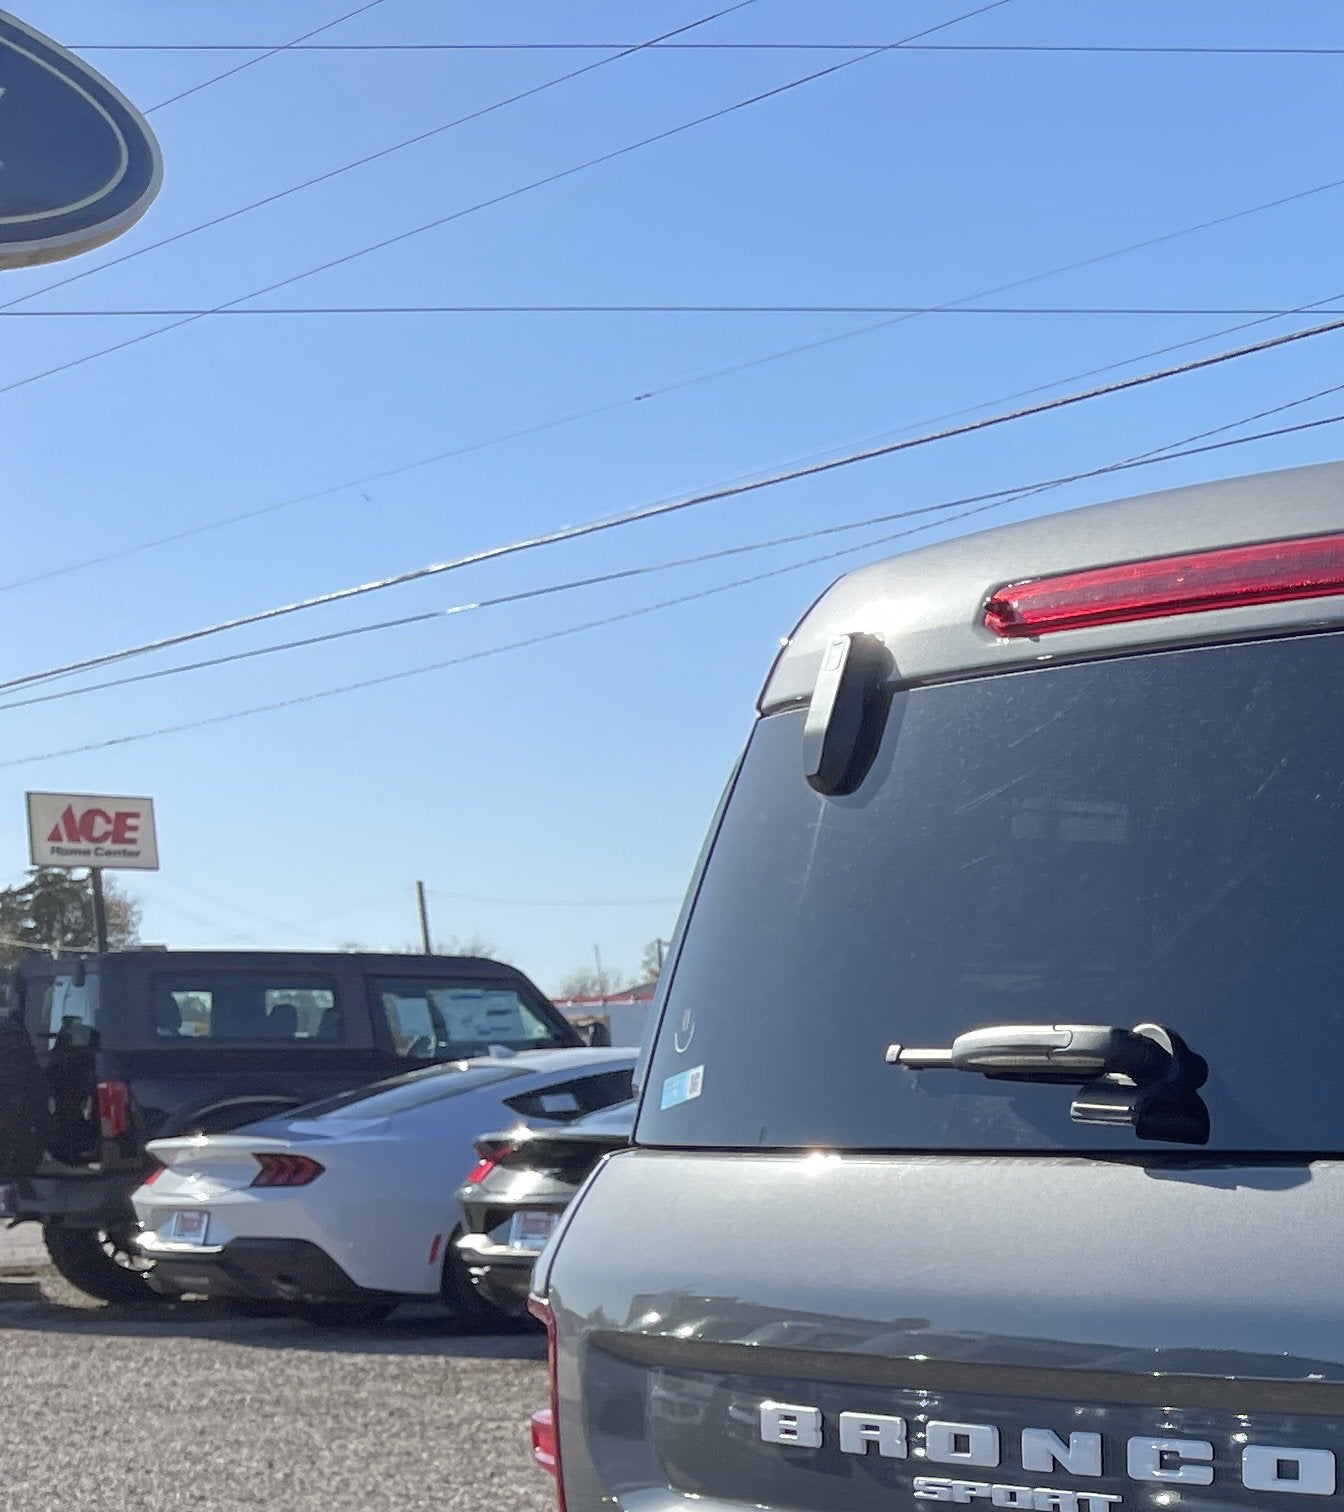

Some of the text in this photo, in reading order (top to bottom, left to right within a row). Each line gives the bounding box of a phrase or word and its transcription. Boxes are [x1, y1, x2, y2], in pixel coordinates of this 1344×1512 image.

[48, 803, 141, 844] ACE
[93, 846, 141, 858] Center
[759, 1400, 1336, 1496] BRONCO
